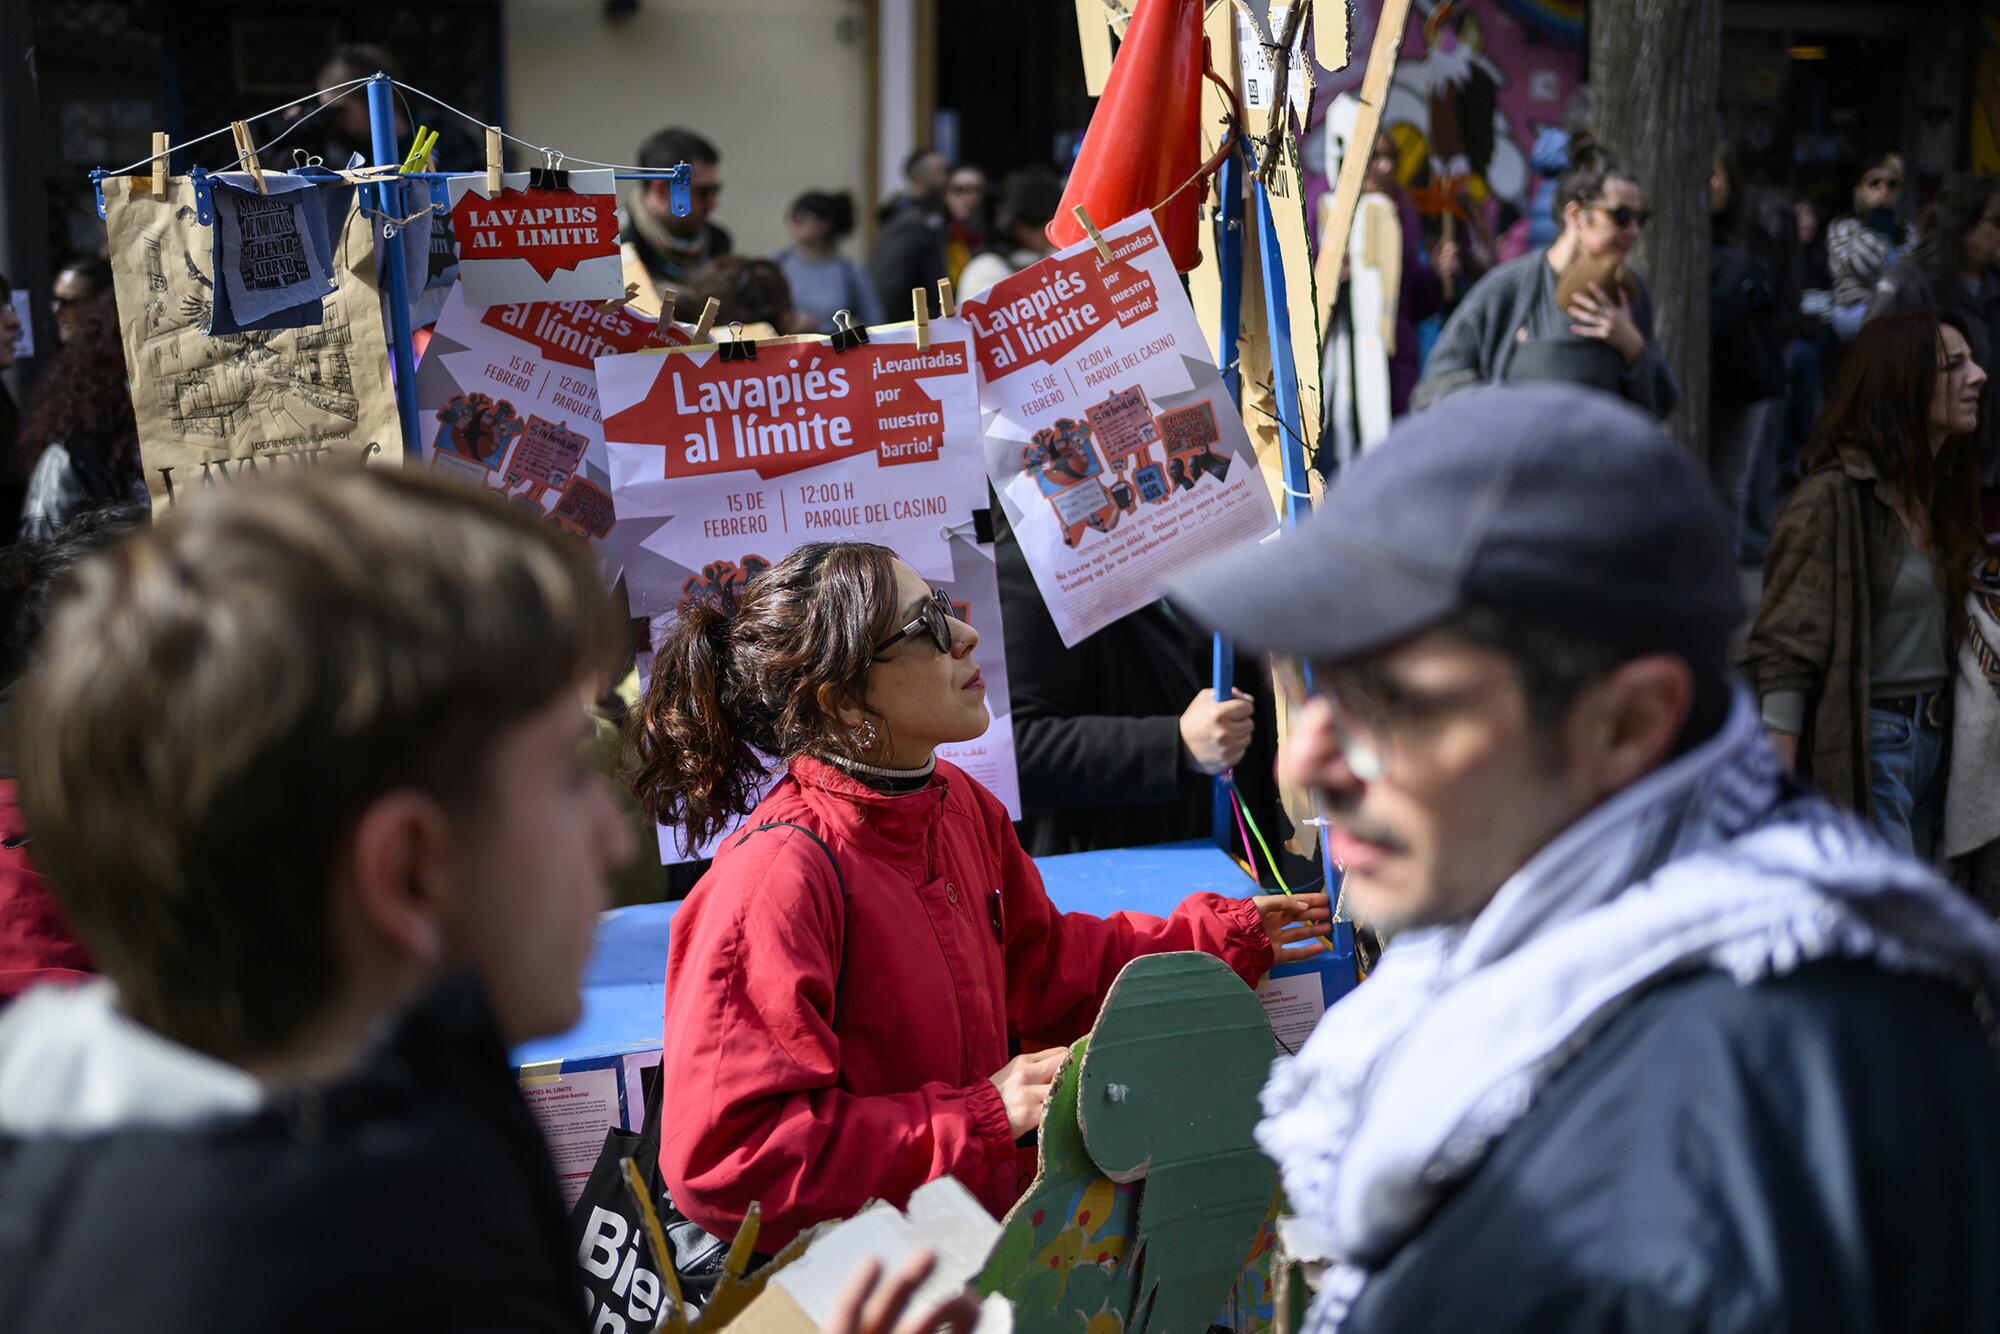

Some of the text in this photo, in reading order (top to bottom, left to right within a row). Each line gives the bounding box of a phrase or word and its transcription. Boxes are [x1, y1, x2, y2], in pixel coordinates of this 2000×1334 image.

[468, 206, 597, 227] LAVAPIES
[472, 227, 599, 249] AL LIMITE
[1094, 233, 1153, 272] ¡Lantadas
[254, 258, 295, 278] AIRBNB
[1102, 271, 1120, 289] por
[969, 270, 1087, 339] Lavapiés
[1110, 279, 1150, 305] nuestro
[501, 302, 532, 331] al
[1117, 296, 1153, 322] barrio!
[991, 303, 1100, 369] al límite
[509, 355, 538, 377] 15 DE
[872, 350, 963, 380] ¡Levantadas
[1076, 345, 1113, 373] 12:00 H
[1084, 333, 1176, 389] PARQUE DEL CASINO
[484, 363, 530, 393] FEBRERO
[558, 375, 600, 402] 12:00 H
[672, 357, 850, 417] Lavapiés
[1030, 373, 1059, 395] 15 DE
[552, 392, 593, 420] PARQUE
[875, 388, 901, 407] por
[1021, 389, 1065, 417] FEBRERO
[879, 411, 939, 430] nuestro
[684, 407, 854, 464] al límite
[881, 435, 933, 458] barrio!
[727, 491, 766, 512] 15 DE
[799, 482, 854, 505] 12:00 H
[805, 495, 948, 530] PARQUE DEL CASINO
[703, 514, 768, 539] FEBRERO
